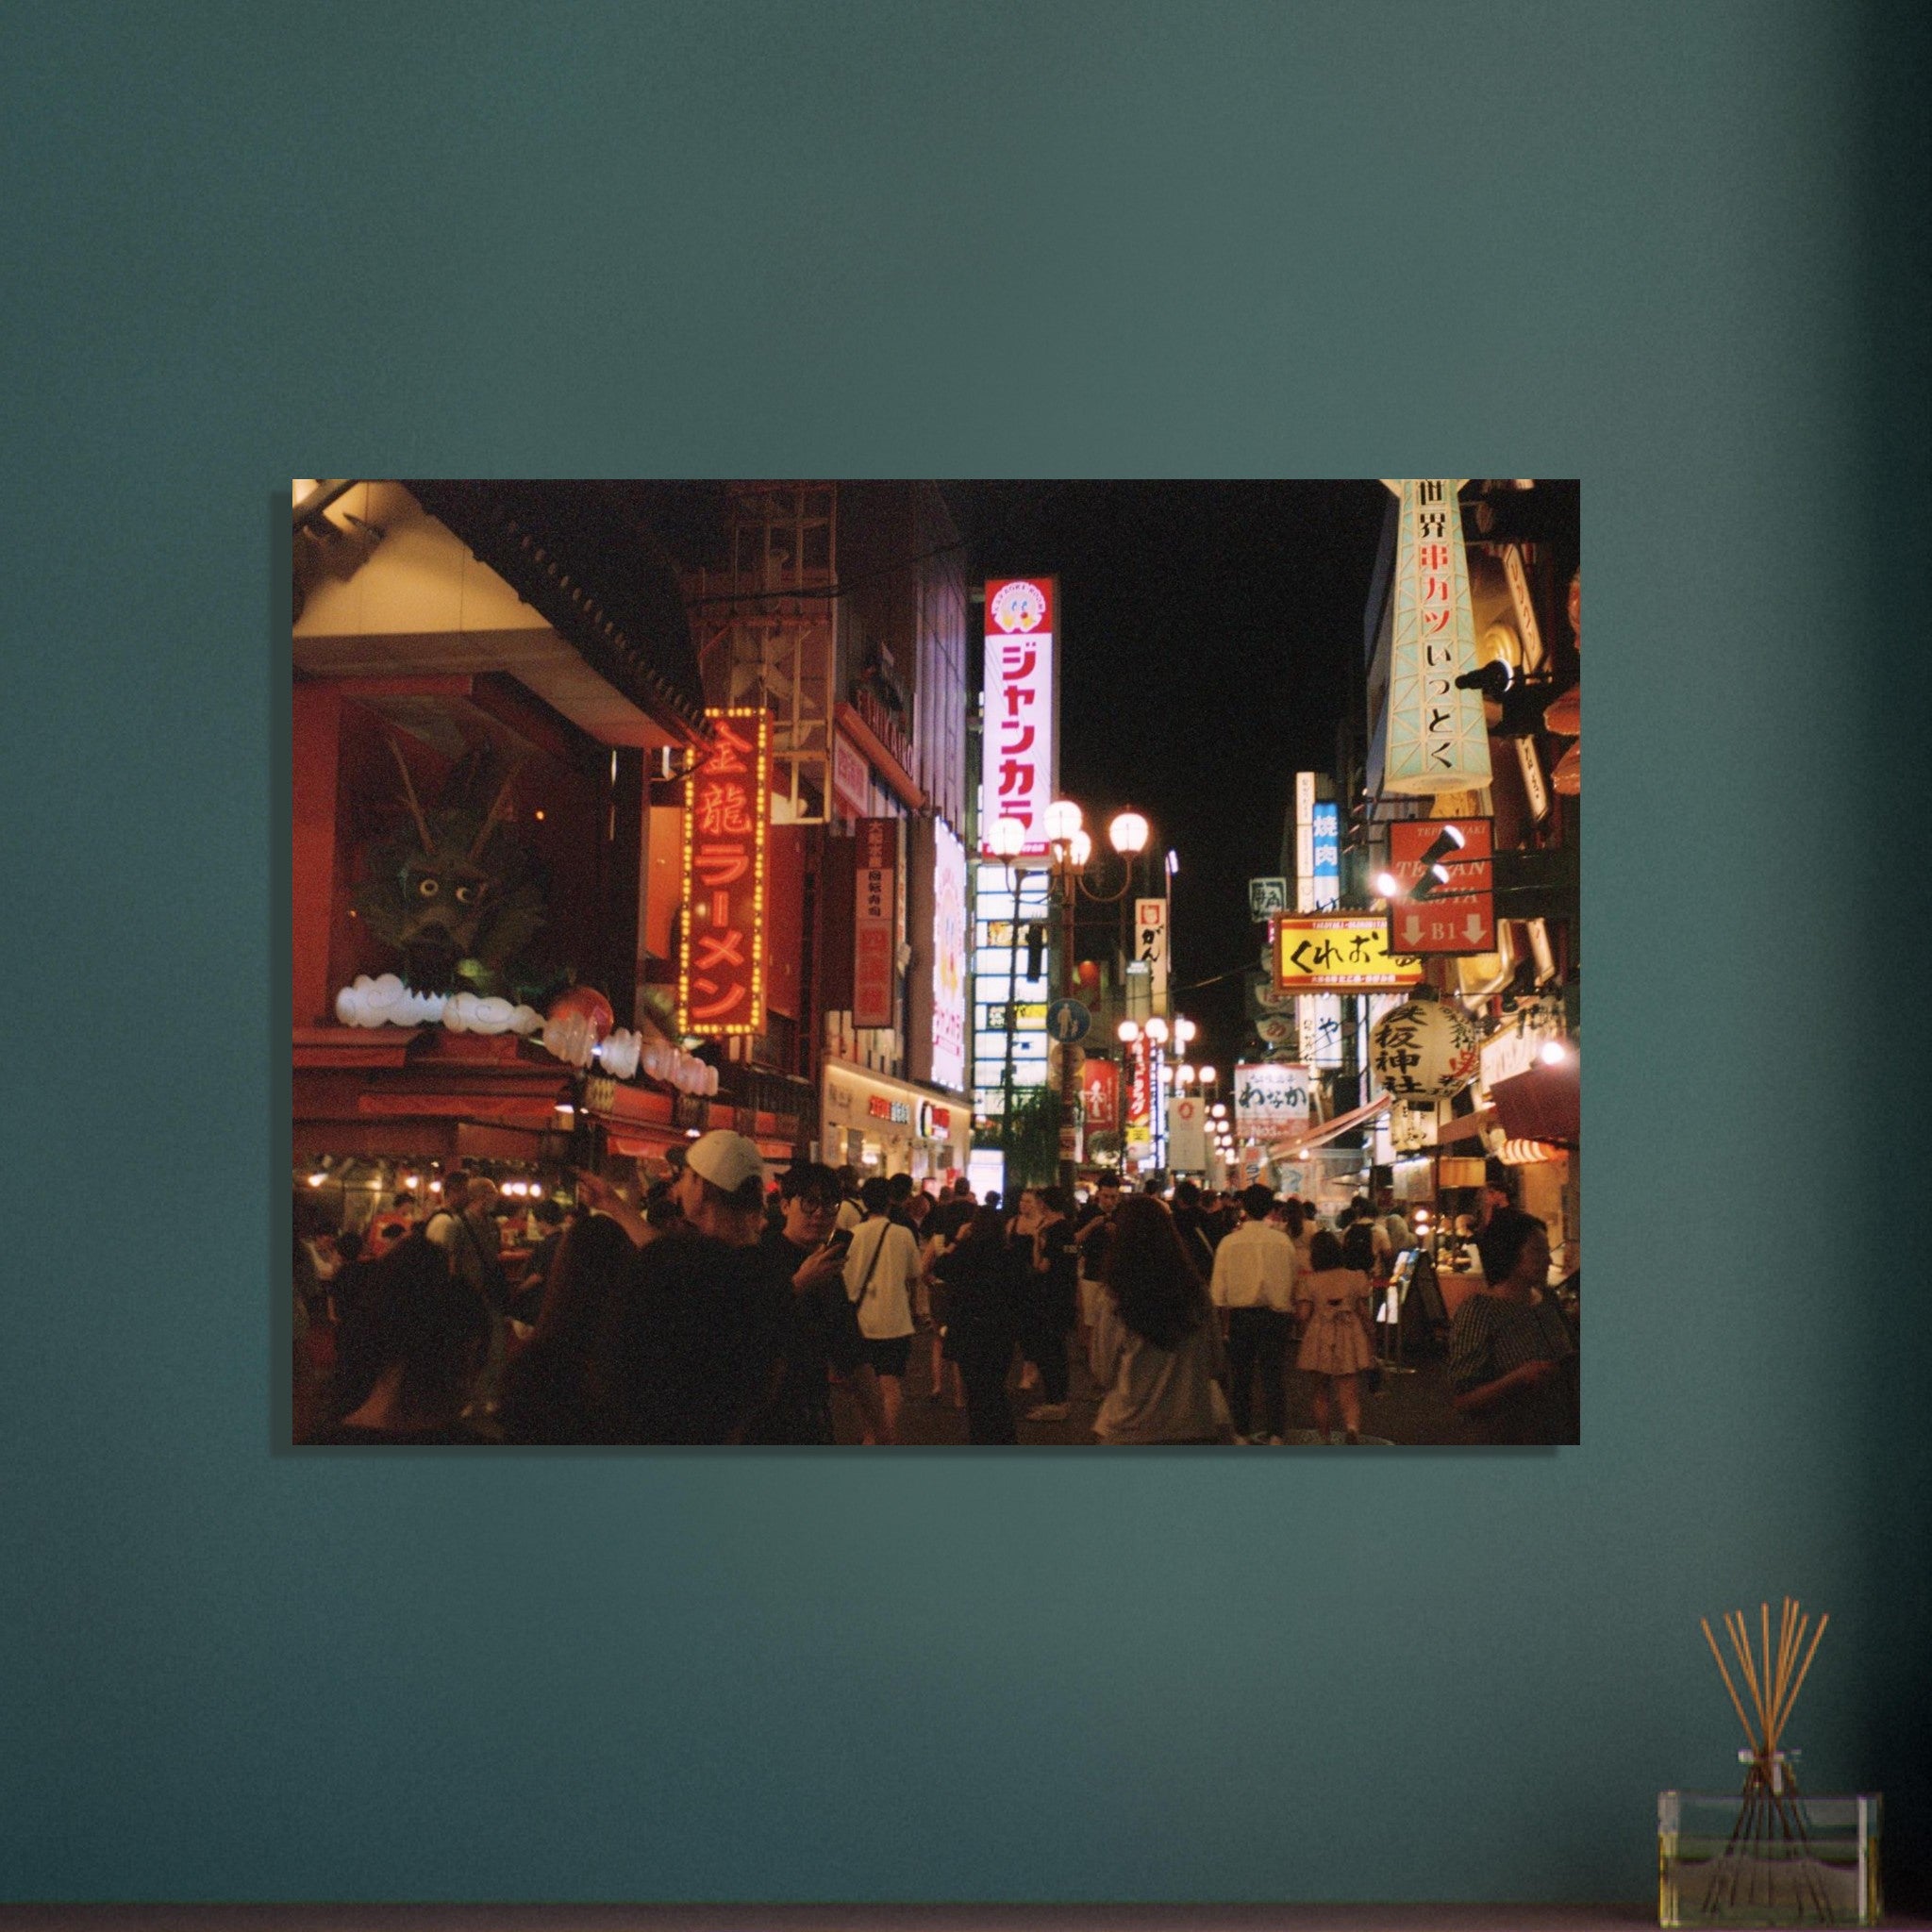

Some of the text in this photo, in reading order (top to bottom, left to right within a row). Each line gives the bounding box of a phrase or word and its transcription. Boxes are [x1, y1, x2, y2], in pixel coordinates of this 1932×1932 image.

[1420, 479, 1452, 769] 世界串カツいっとく
[998, 641, 1037, 830] ジャンカラ
[1313, 815, 1339, 866] 焼肉
[692, 720, 753, 1020] 金龍ラーメン
[1396, 860, 1485, 878] TEAN
[1431, 923, 1456, 941] B1
[1239, 1082, 1307, 1108] わなか
